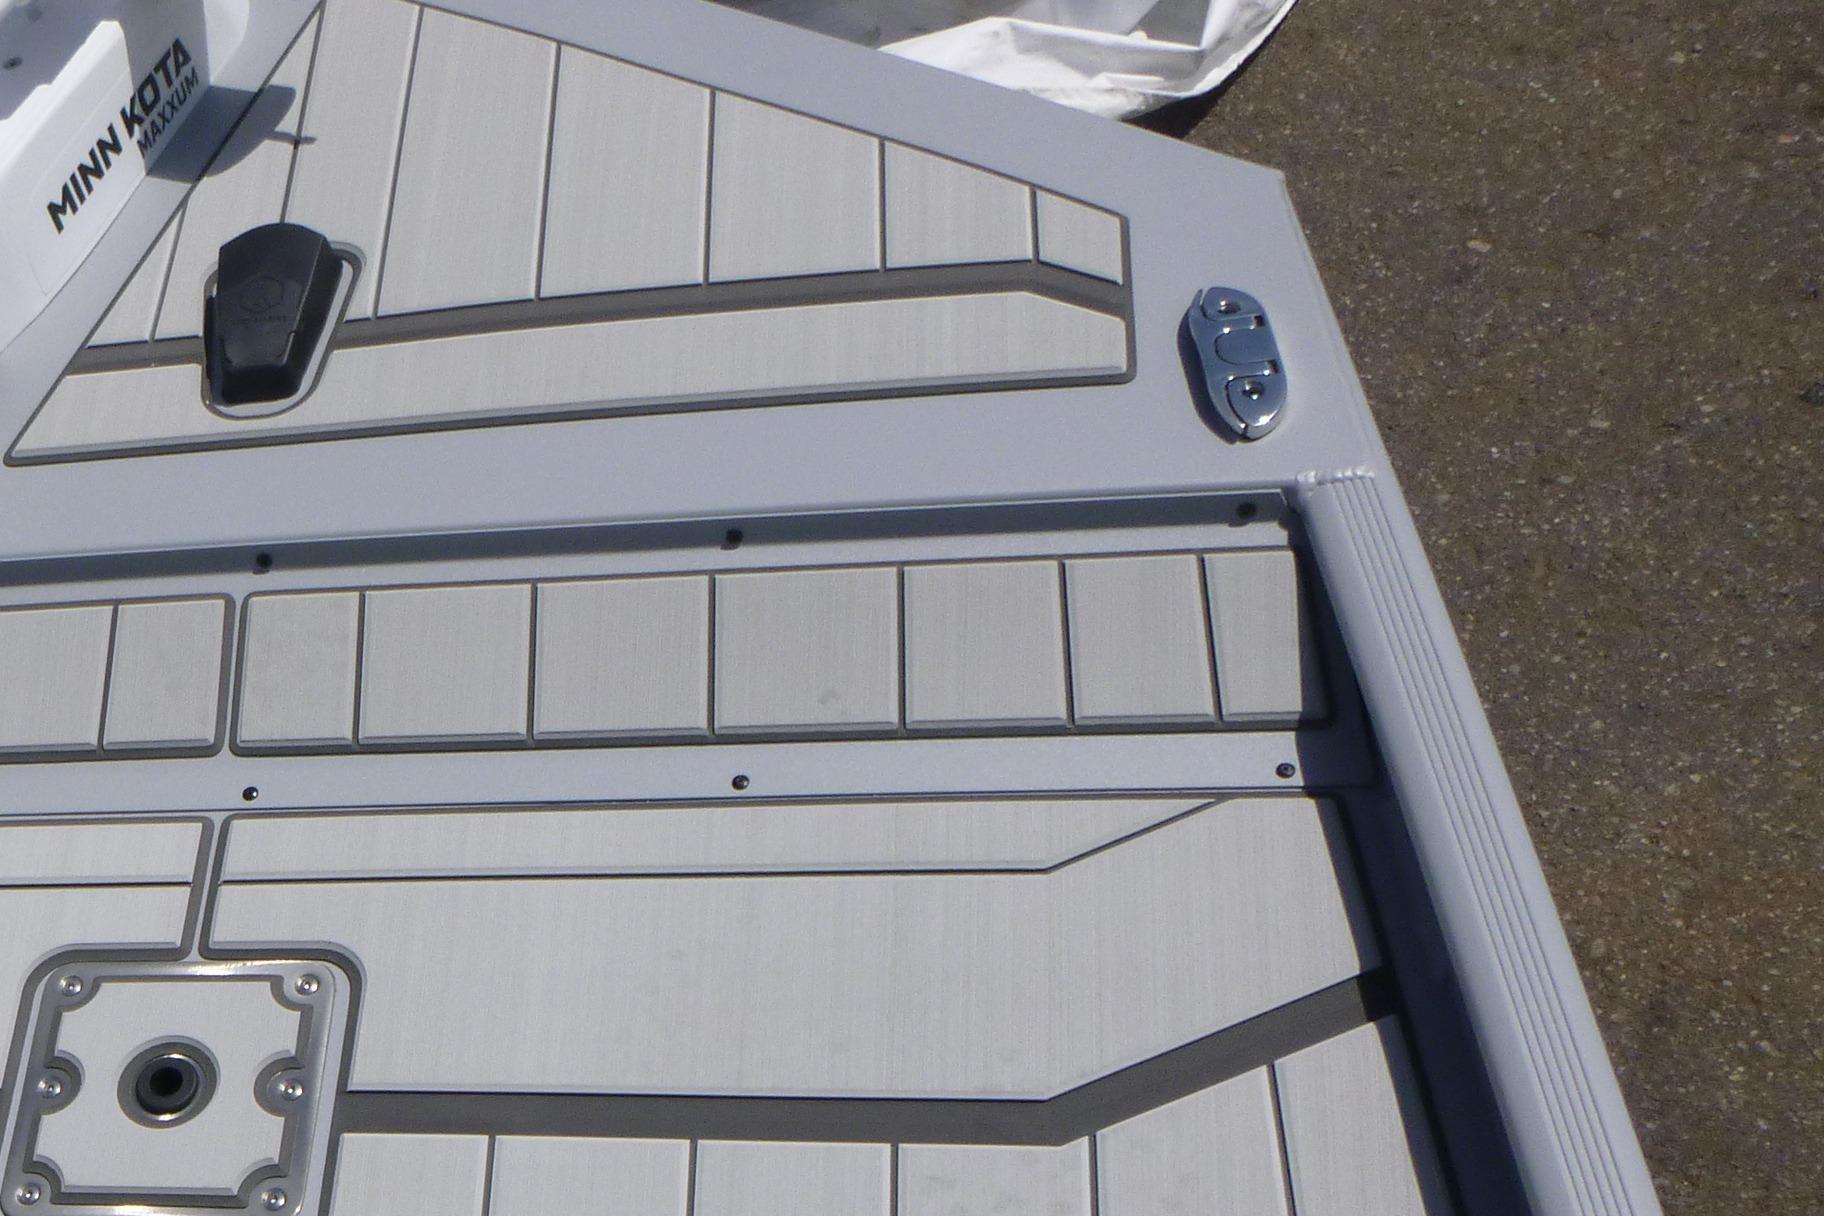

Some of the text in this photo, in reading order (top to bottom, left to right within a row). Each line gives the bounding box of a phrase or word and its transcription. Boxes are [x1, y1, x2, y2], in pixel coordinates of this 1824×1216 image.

[46, 37, 193, 235] MINN KOTA
[136, 65, 200, 159] MAXXUM
